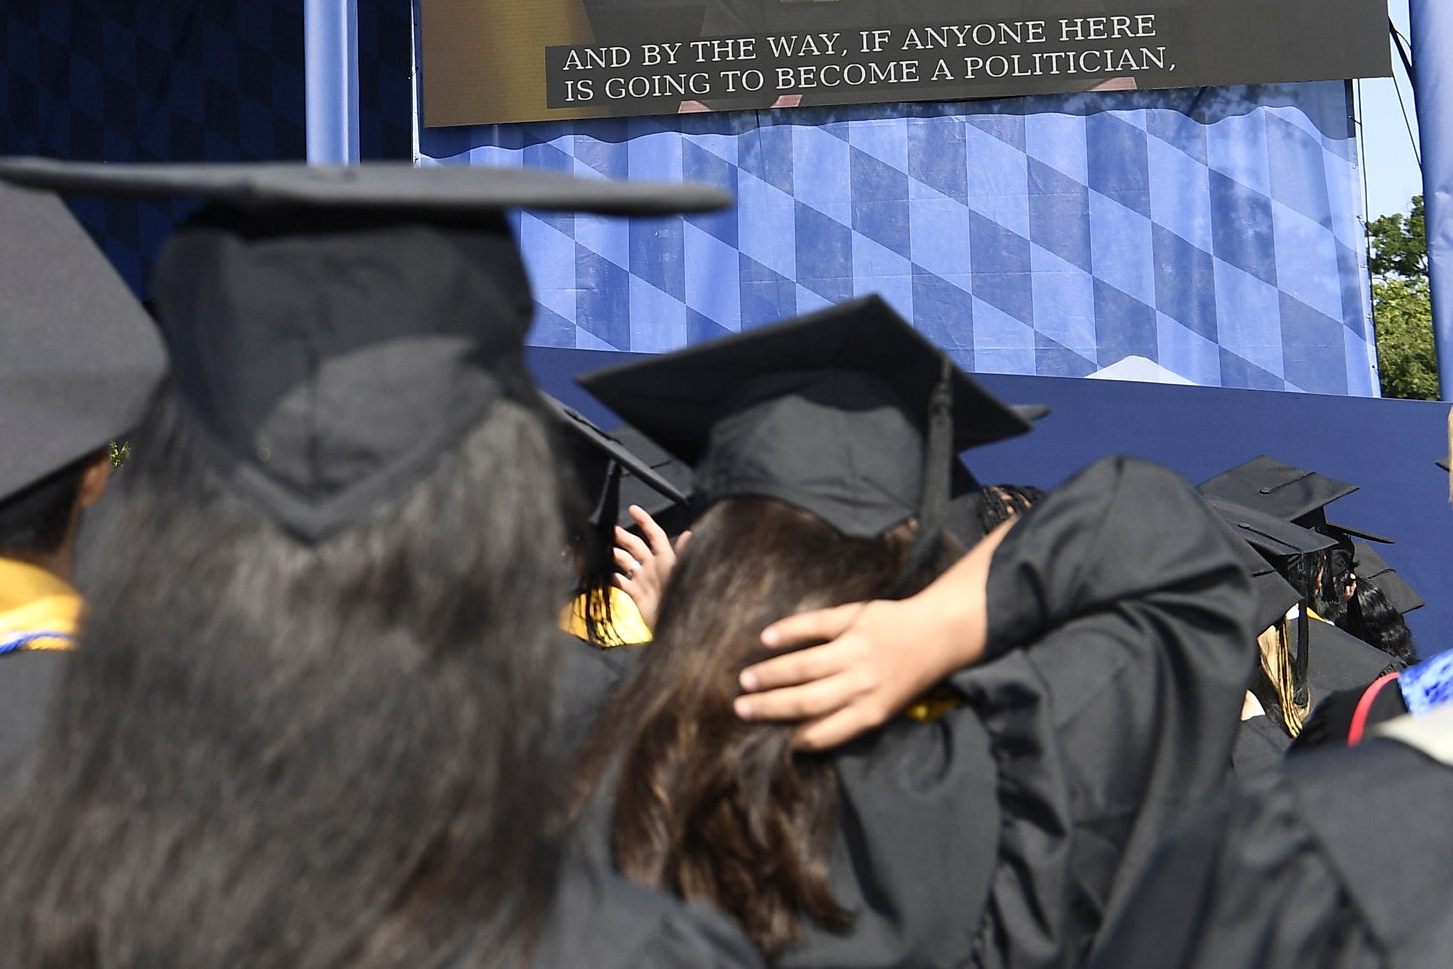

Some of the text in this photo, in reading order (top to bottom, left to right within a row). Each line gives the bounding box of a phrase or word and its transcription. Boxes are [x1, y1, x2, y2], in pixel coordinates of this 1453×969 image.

[562, 14, 1157, 70] AND BY THE WAY, IF ANYONE HERE
[565, 46, 1177, 102] IS GOING TO BECOME A POLITICIAN,
